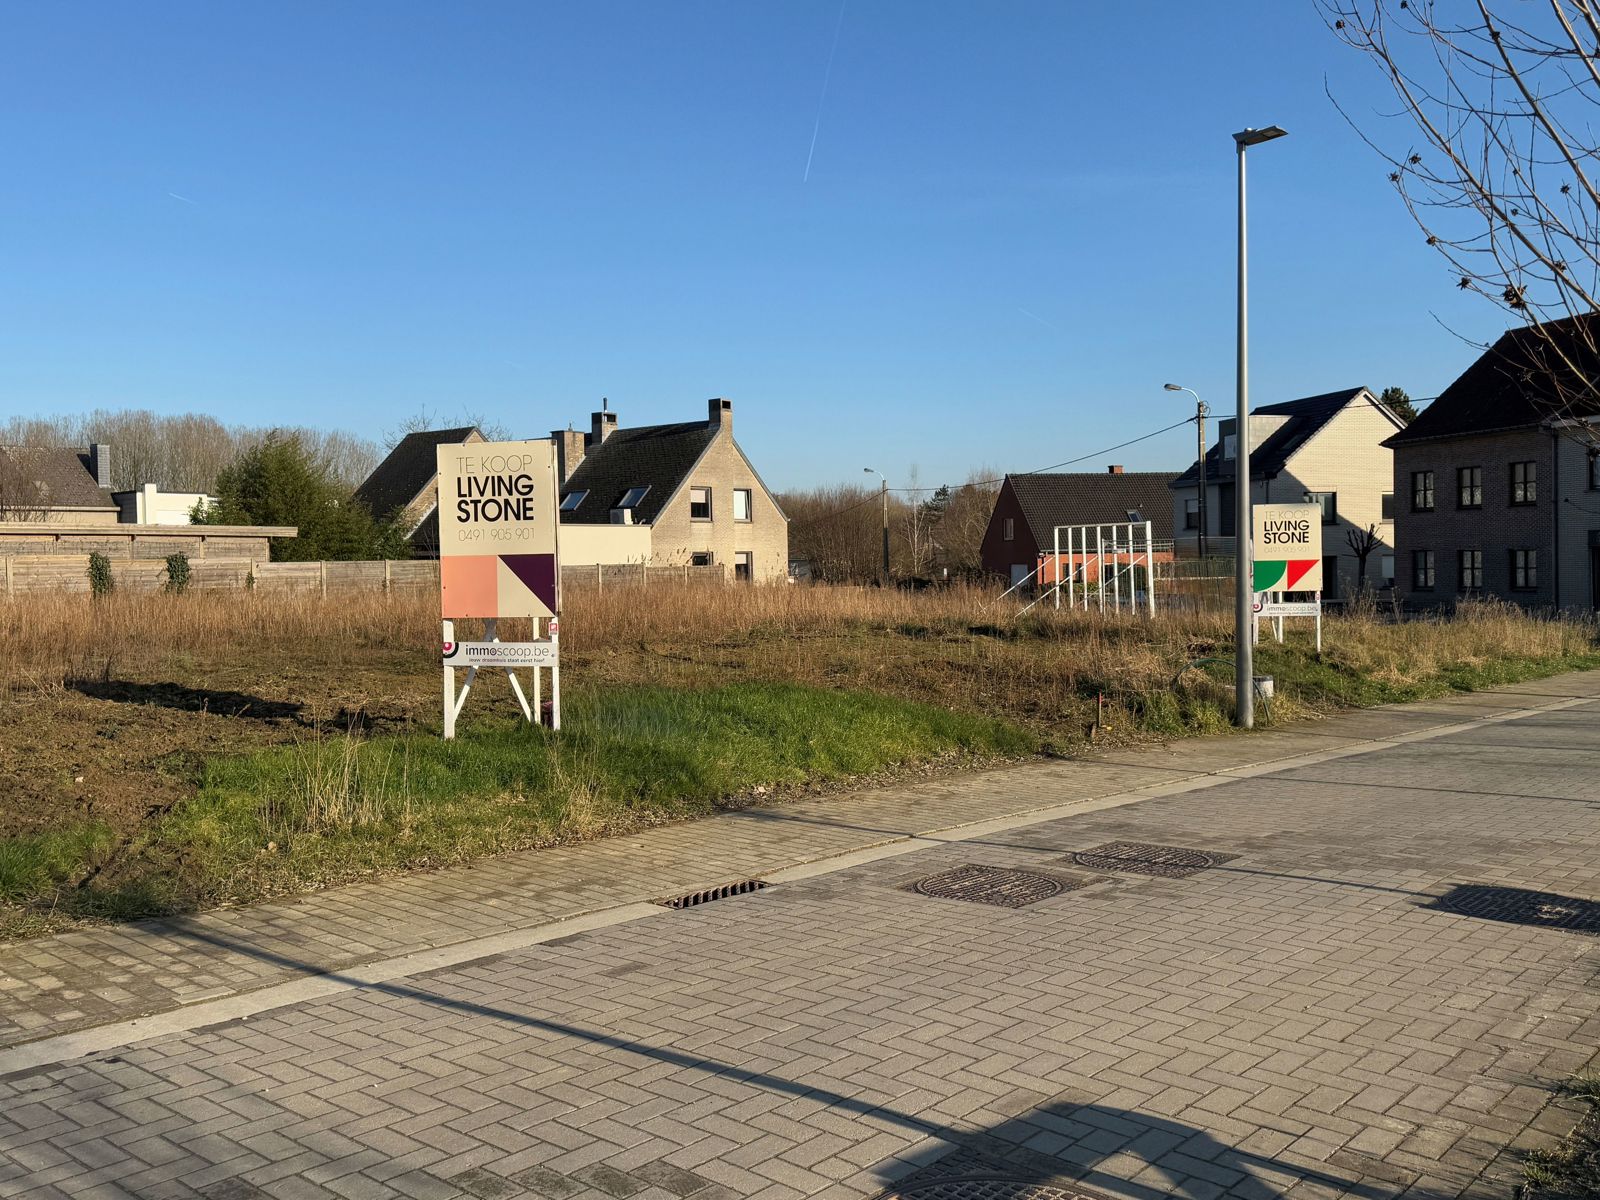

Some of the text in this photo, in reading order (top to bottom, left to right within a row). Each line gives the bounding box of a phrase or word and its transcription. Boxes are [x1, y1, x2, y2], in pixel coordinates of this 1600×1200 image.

[456, 454, 533, 474] TE KOOP
[457, 474, 534, 498] LIVING
[457, 497, 534, 523] STONE
[1265, 509, 1310, 520] TE KOOP
[1264, 519, 1310, 532] LIVING
[458, 527, 535, 542] 0491 905 901
[1264, 531, 1309, 544] STONE
[466, 645, 549, 658] immoscoop.be
